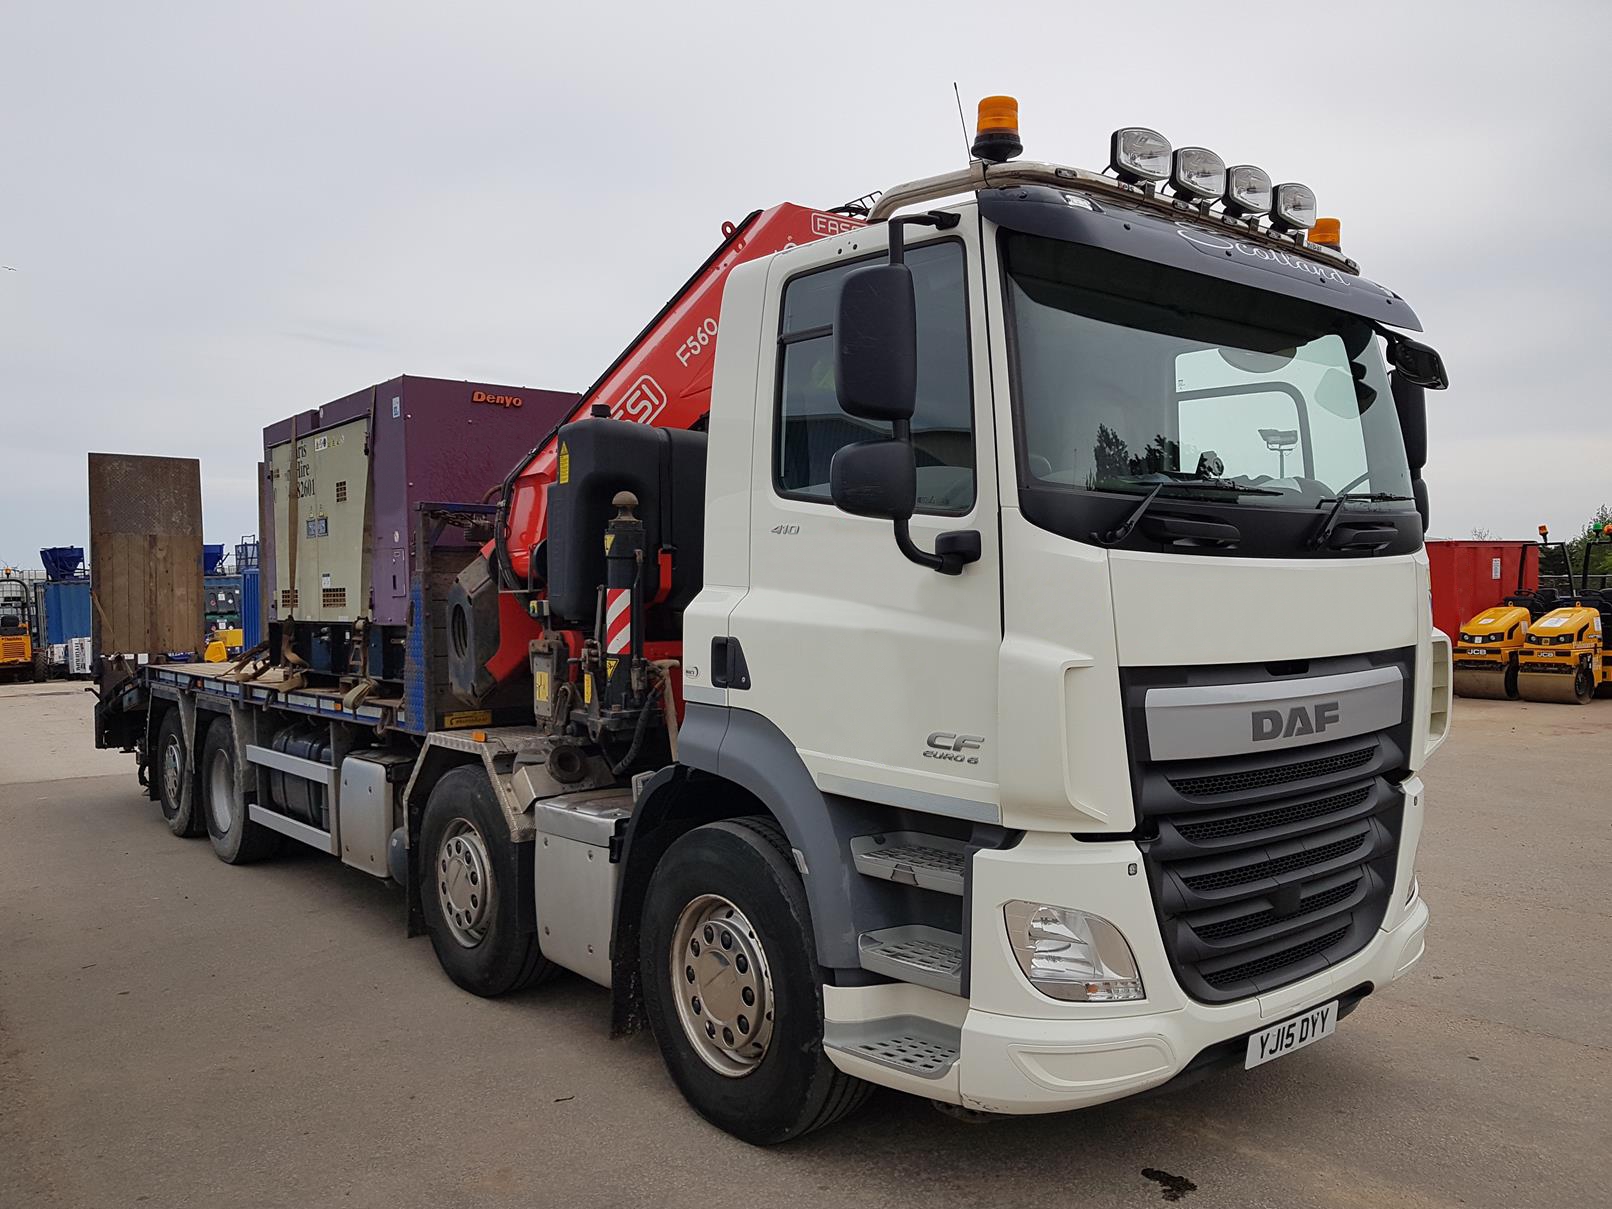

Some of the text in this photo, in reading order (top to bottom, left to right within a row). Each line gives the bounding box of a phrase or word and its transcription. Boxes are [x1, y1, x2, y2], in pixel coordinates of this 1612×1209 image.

[816, 217, 861, 235] FAS
[471, 391, 523, 407] Denyo
[770, 524, 801, 535] 410
[1467, 648, 1488, 656] JCB
[1251, 701, 1340, 742] DAF
[926, 731, 986, 752] CF
[922, 750, 979, 765] EURO 6
[1260, 1007, 1330, 1059] YJ15 DYY
